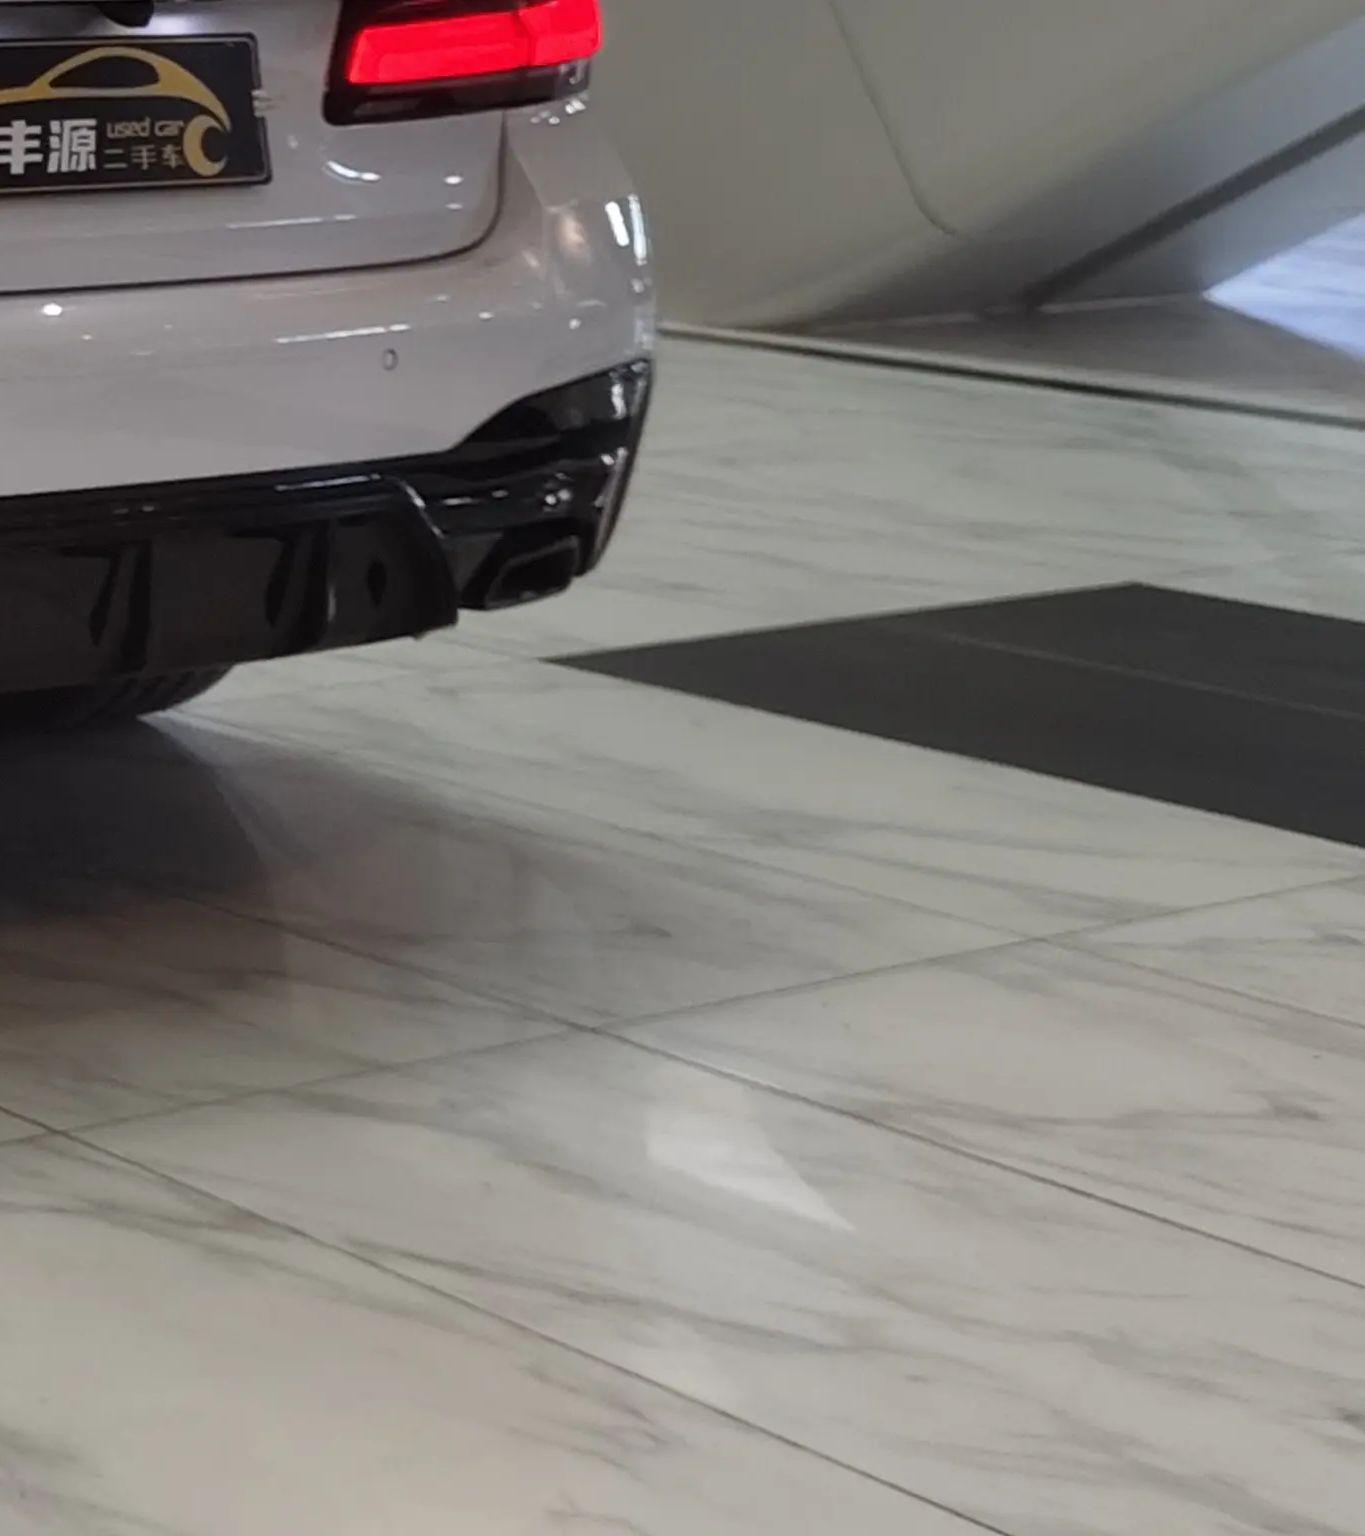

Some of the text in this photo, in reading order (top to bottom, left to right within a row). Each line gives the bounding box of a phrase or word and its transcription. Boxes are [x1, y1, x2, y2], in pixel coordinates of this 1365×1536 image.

[106, 118, 186, 139] used car
[103, 144, 185, 171] 二手车
